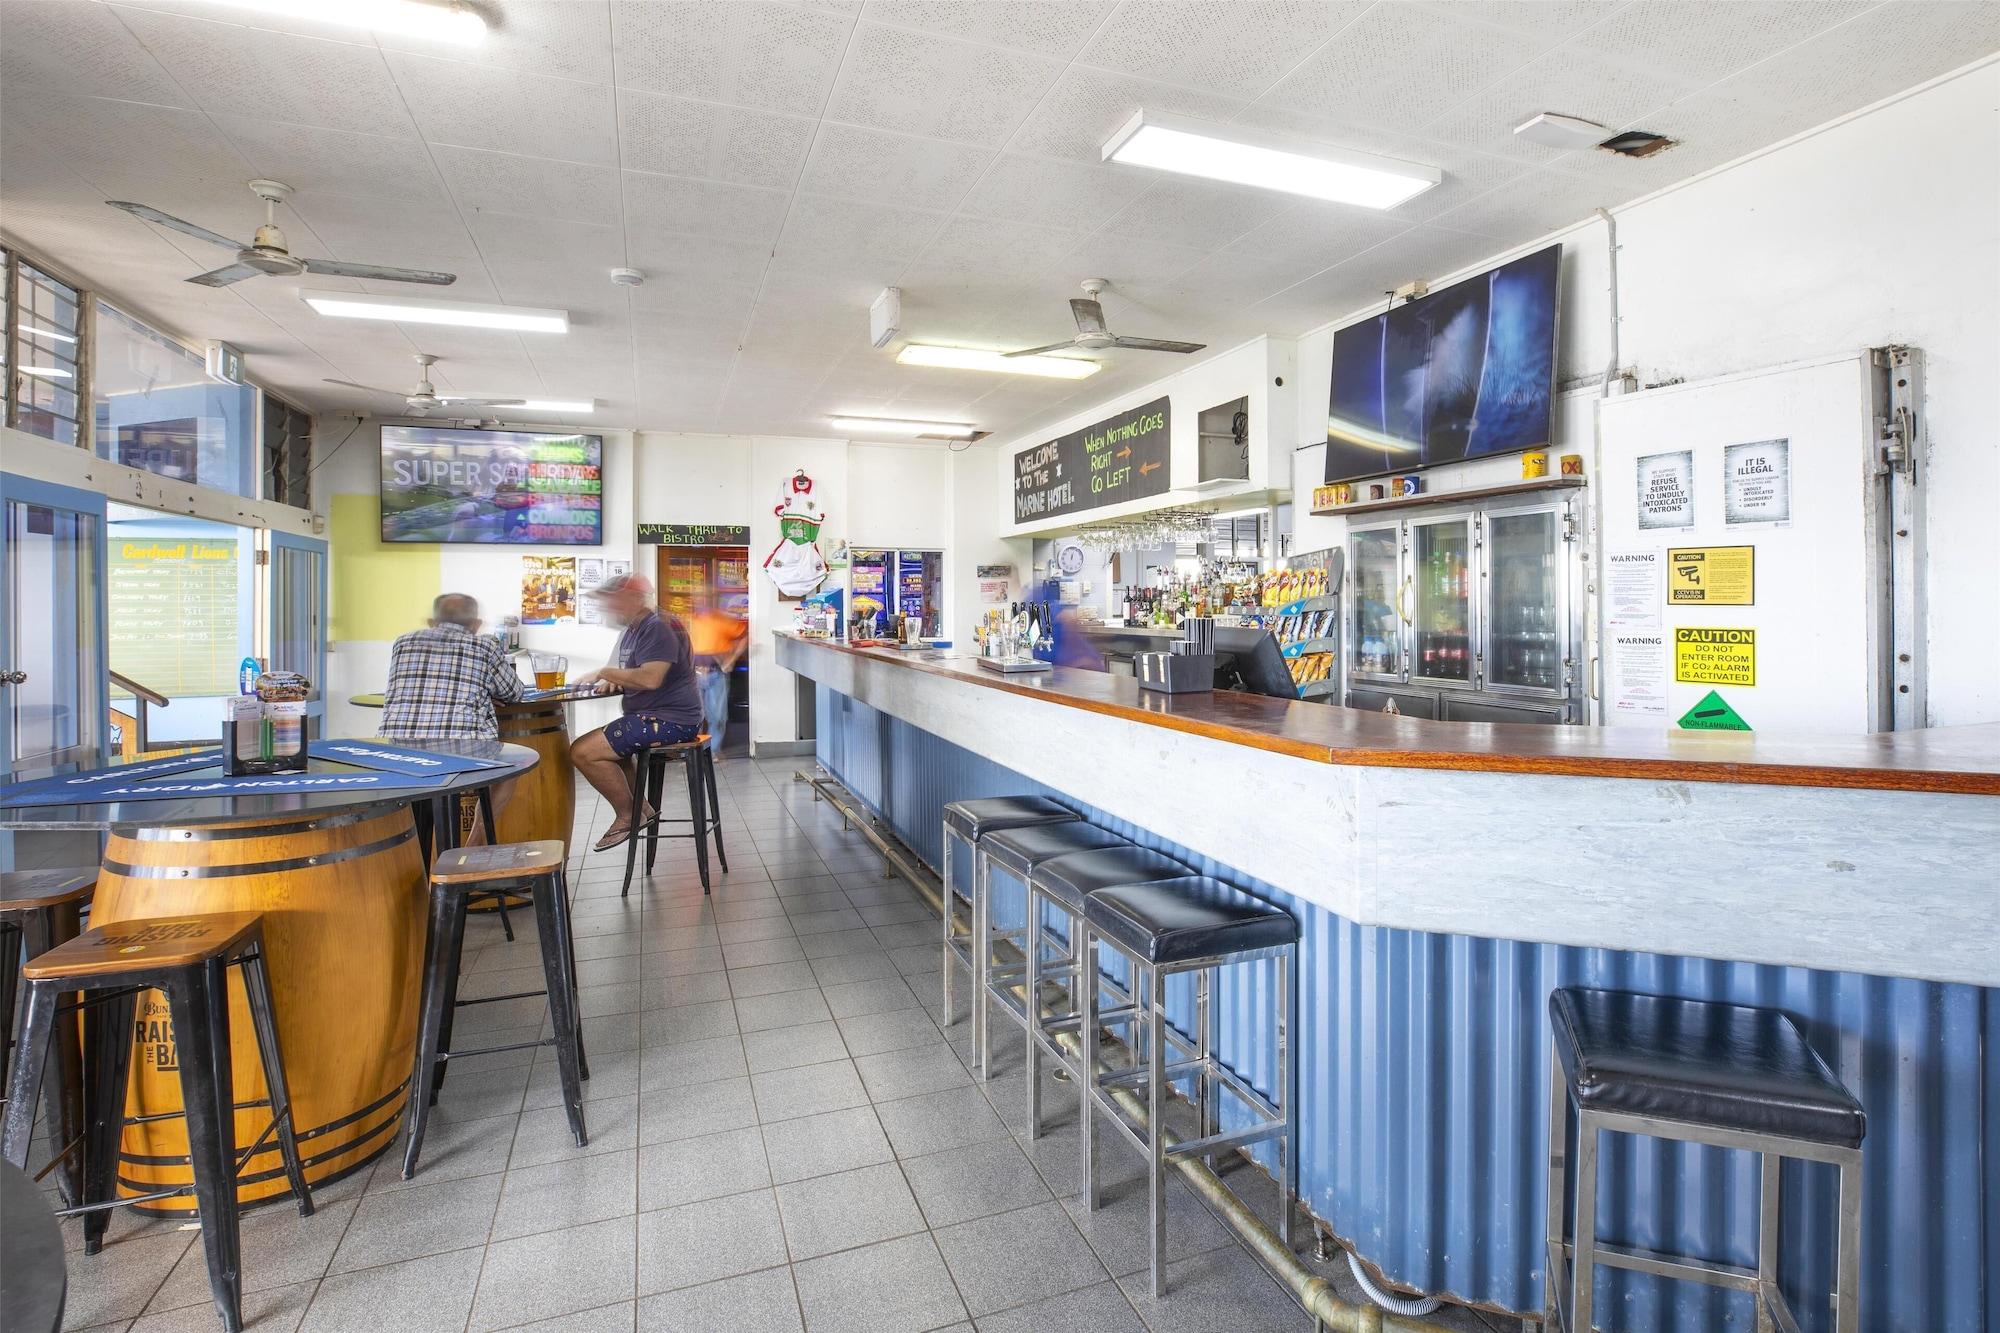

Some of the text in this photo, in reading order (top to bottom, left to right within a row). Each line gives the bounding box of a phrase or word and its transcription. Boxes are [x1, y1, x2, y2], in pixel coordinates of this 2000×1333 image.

[1084, 413, 1164, 454] WHEN NOTHING GOES
[1019, 441, 1059, 475] WELCOME
[1091, 451, 1113, 472] RIGHT
[1745, 457, 1766, 467] IT IS
[393, 460, 482, 486] SUPER
[1737, 464, 1774, 476] ILLEGAL
[1022, 470, 1049, 489] TO THE
[1091, 466, 1131, 494] GO LEFT
[1651, 477, 1678, 486] REFUSE
[1650, 484, 1680, 493] SERVICE
[1646, 490, 1685, 501] TO UNDULY
[1016, 491, 1045, 518] MARINE
[1643, 497, 1688, 507] INTOXICATED
[1649, 505, 1682, 514] PATRONS
[529, 510, 596, 525] COWBOYS
[529, 526, 594, 541] BRONCOS
[638, 524, 743, 536] WALK THRU TO
[663, 533, 705, 545] BISTRO
[523, 557, 543, 568] the
[1610, 554, 1655, 563] WARNING
[1617, 637, 1662, 645] WARNING
[1677, 629, 1753, 643] CAUTION
[1695, 644, 1734, 653] DO NOT
[1681, 653, 1749, 663] ENTER ROOM
[1681, 662, 1689, 670] IF
[1713, 664, 1750, 672] ALARM
[1681, 671, 1749, 682] IS ACTIVATED
[101, 777, 379, 796] CARLTON DRY
[92, 927, 213, 947] RAISING
[146, 1046, 154, 1064] THE
